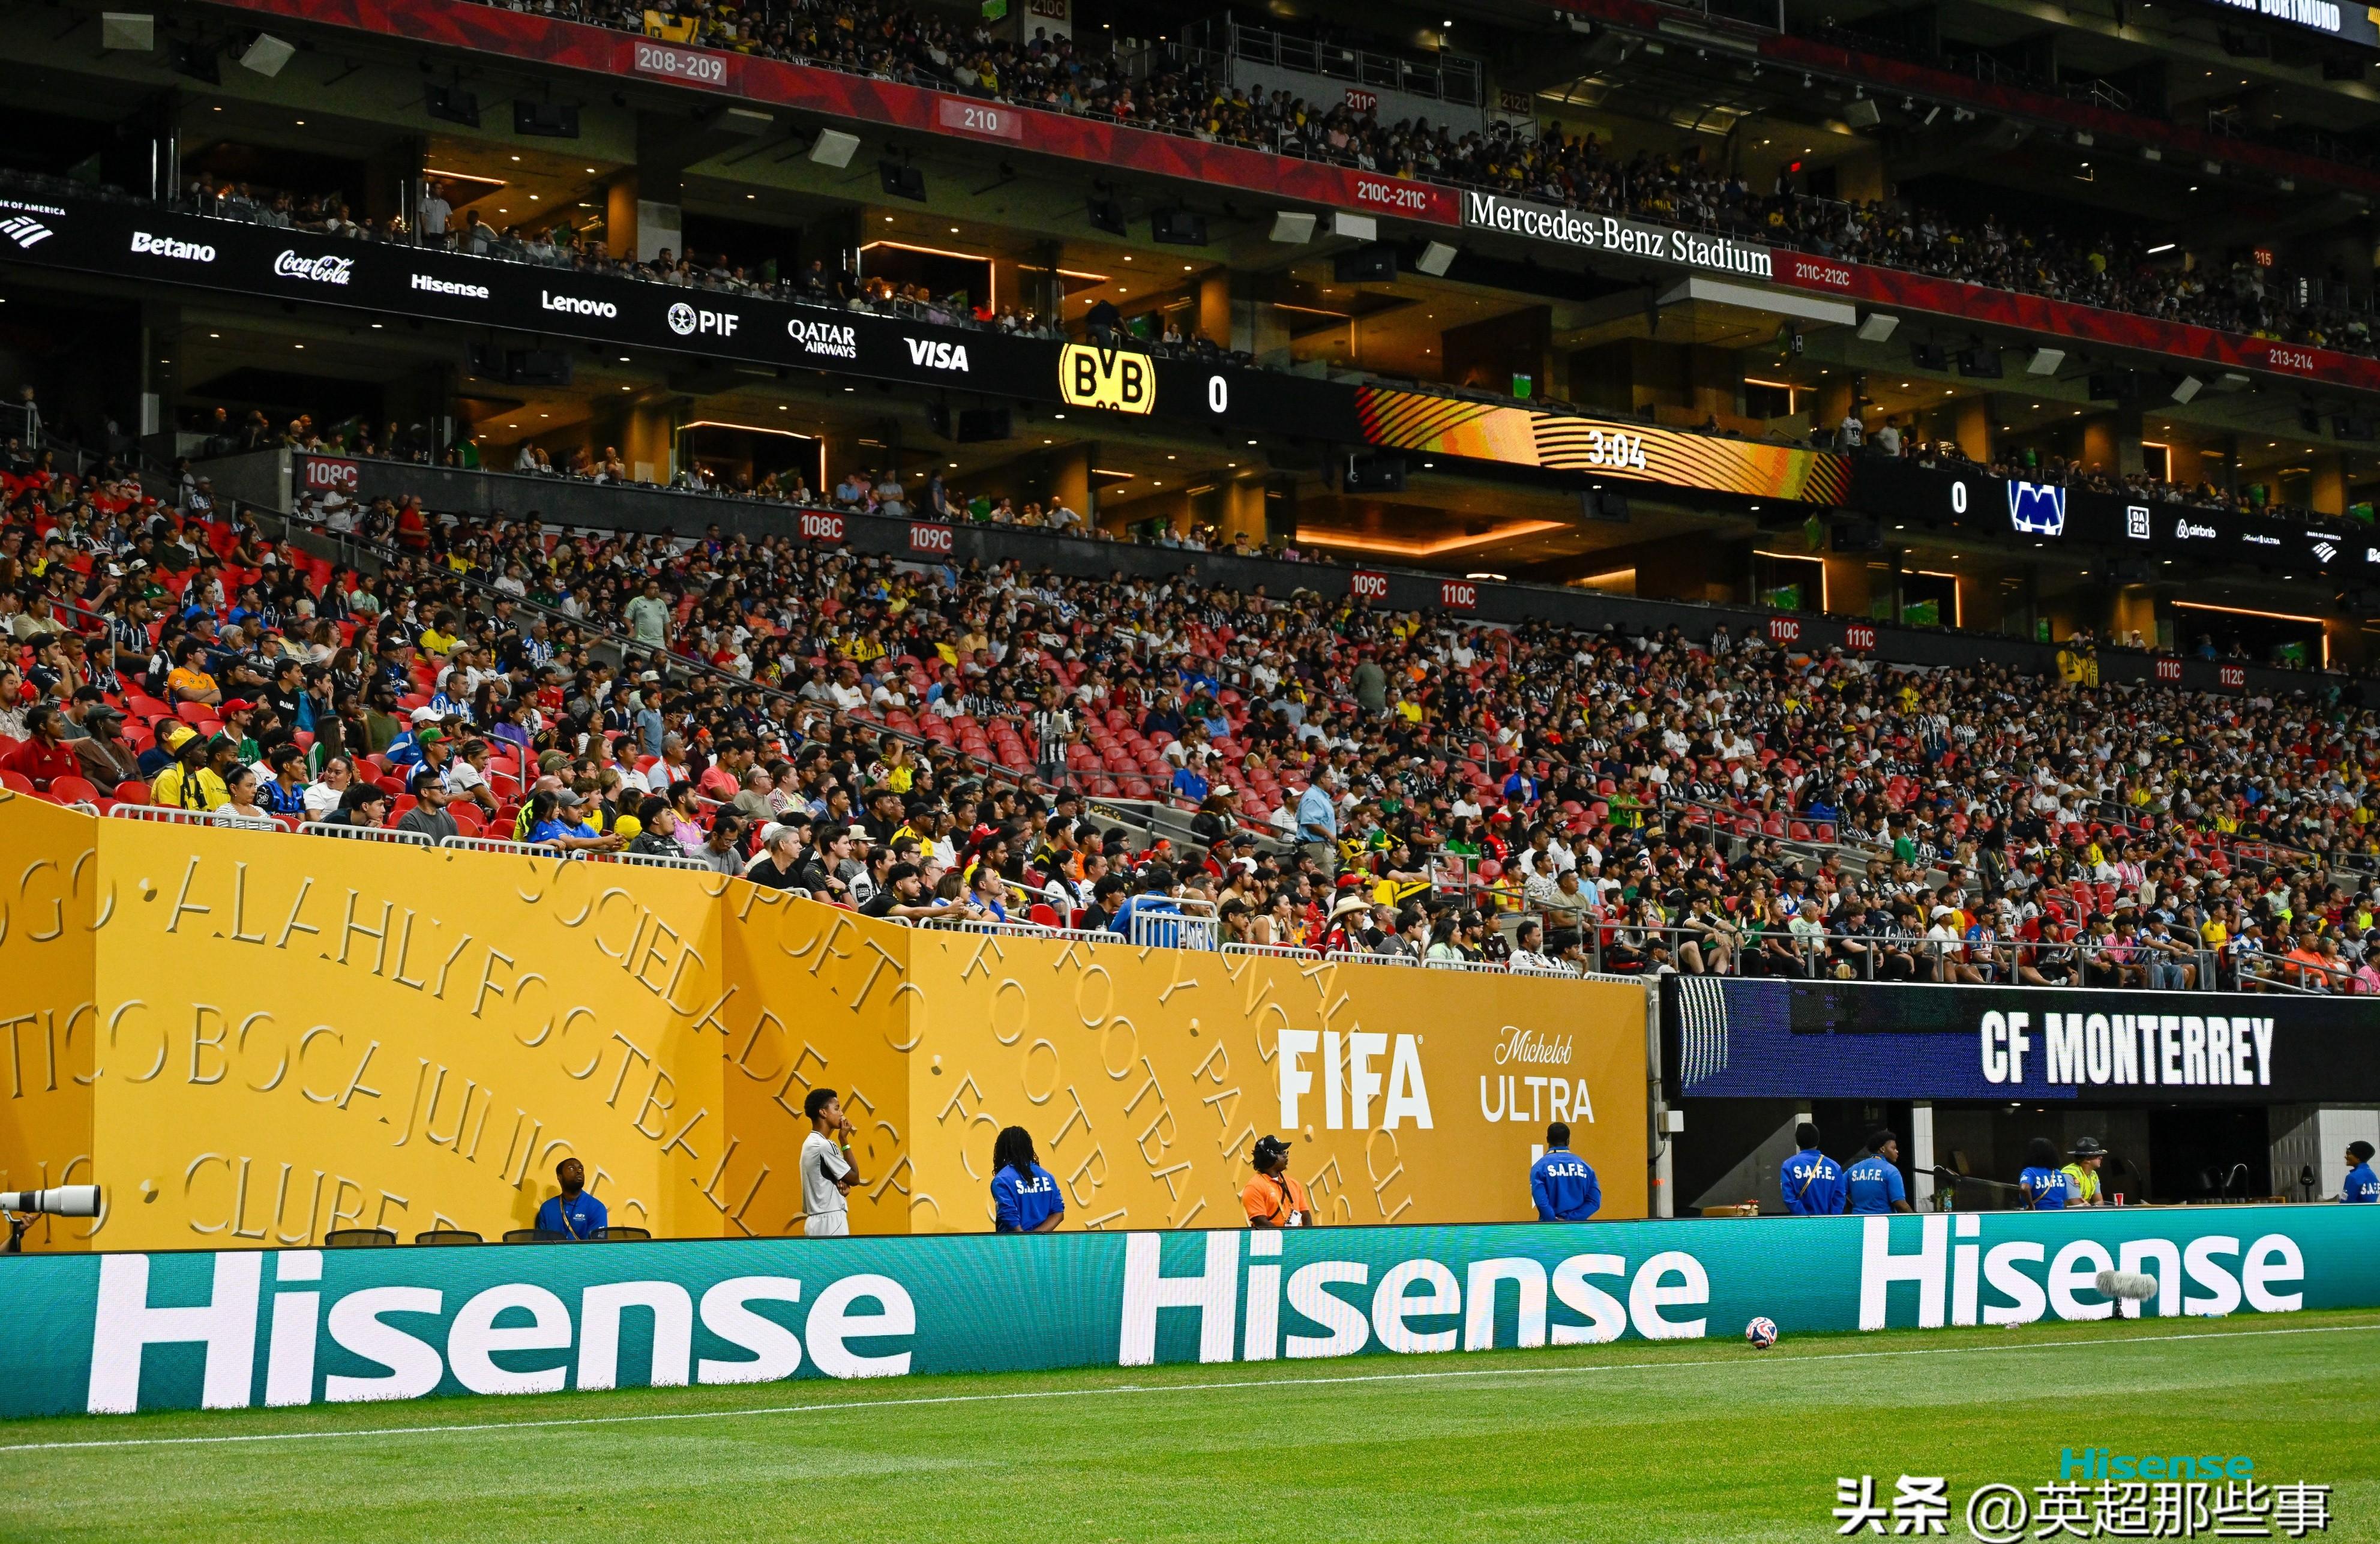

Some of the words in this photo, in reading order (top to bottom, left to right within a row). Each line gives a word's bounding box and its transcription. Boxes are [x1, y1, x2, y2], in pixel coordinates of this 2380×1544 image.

[640, 47, 722, 80] 208-209
[1502, 94, 1528, 112] 212C
[964, 108, 997, 131] 210
[11, 201, 23, 209] OF
[25, 203, 65, 216] AMERICA
[1357, 181, 1425, 209] 210C-211C
[131, 231, 215, 262] Betano
[1470, 191, 1664, 257] Mercedes-Benz
[1672, 230, 1773, 277] Stadium
[274, 249, 355, 284] Coca-Cola
[1796, 262, 1850, 286] 211C-212C
[411, 274, 489, 299] Hisense
[542, 290, 617, 318] Lenovo
[699, 310, 739, 337] PIF
[787, 319, 856, 346] QATAR
[805, 340, 856, 358] AIRWAYS
[903, 337, 969, 372] VISA
[2270, 349, 2313, 370] 213-214
[1075, 347, 1143, 404] BVB
[1209, 376, 1227, 413] 0
[1588, 430, 1647, 470] 3:04
[307, 462, 357, 487] 108C
[1952, 481, 1967, 514] 0
[801, 515, 843, 538] 108C
[910, 527, 952, 550] 109C
[2190, 524, 2216, 538] airbnb
[2264, 536, 2280, 545] ULTRA
[1353, 575, 1386, 596] 109C
[1443, 584, 1474, 605] 110C
[1770, 620, 1799, 639] 110C
[1847, 628, 1874, 647] 111C
[2157, 661, 2180, 678] 111C
[2220, 668, 2244, 685] 112C
[1494, 1025, 1573, 1065] Michelob
[1981, 1010, 2031, 1083] CF
[2045, 1012, 2275, 1086] MONTERREY
[188, 1001, 390, 1125] BOCA
[1278, 1029, 1434, 1130] FIFA
[1479, 1074, 1595, 1124] ULTRA
[1547, 1163, 1587, 1179] S.A.F.E.
[1852, 1168, 1884, 1182] S.A.F.E.
[1859, 1214, 2304, 1331] Hisense
[1118, 1229, 1710, 1366] Hisense
[86, 1250, 916, 1414] Hisense
